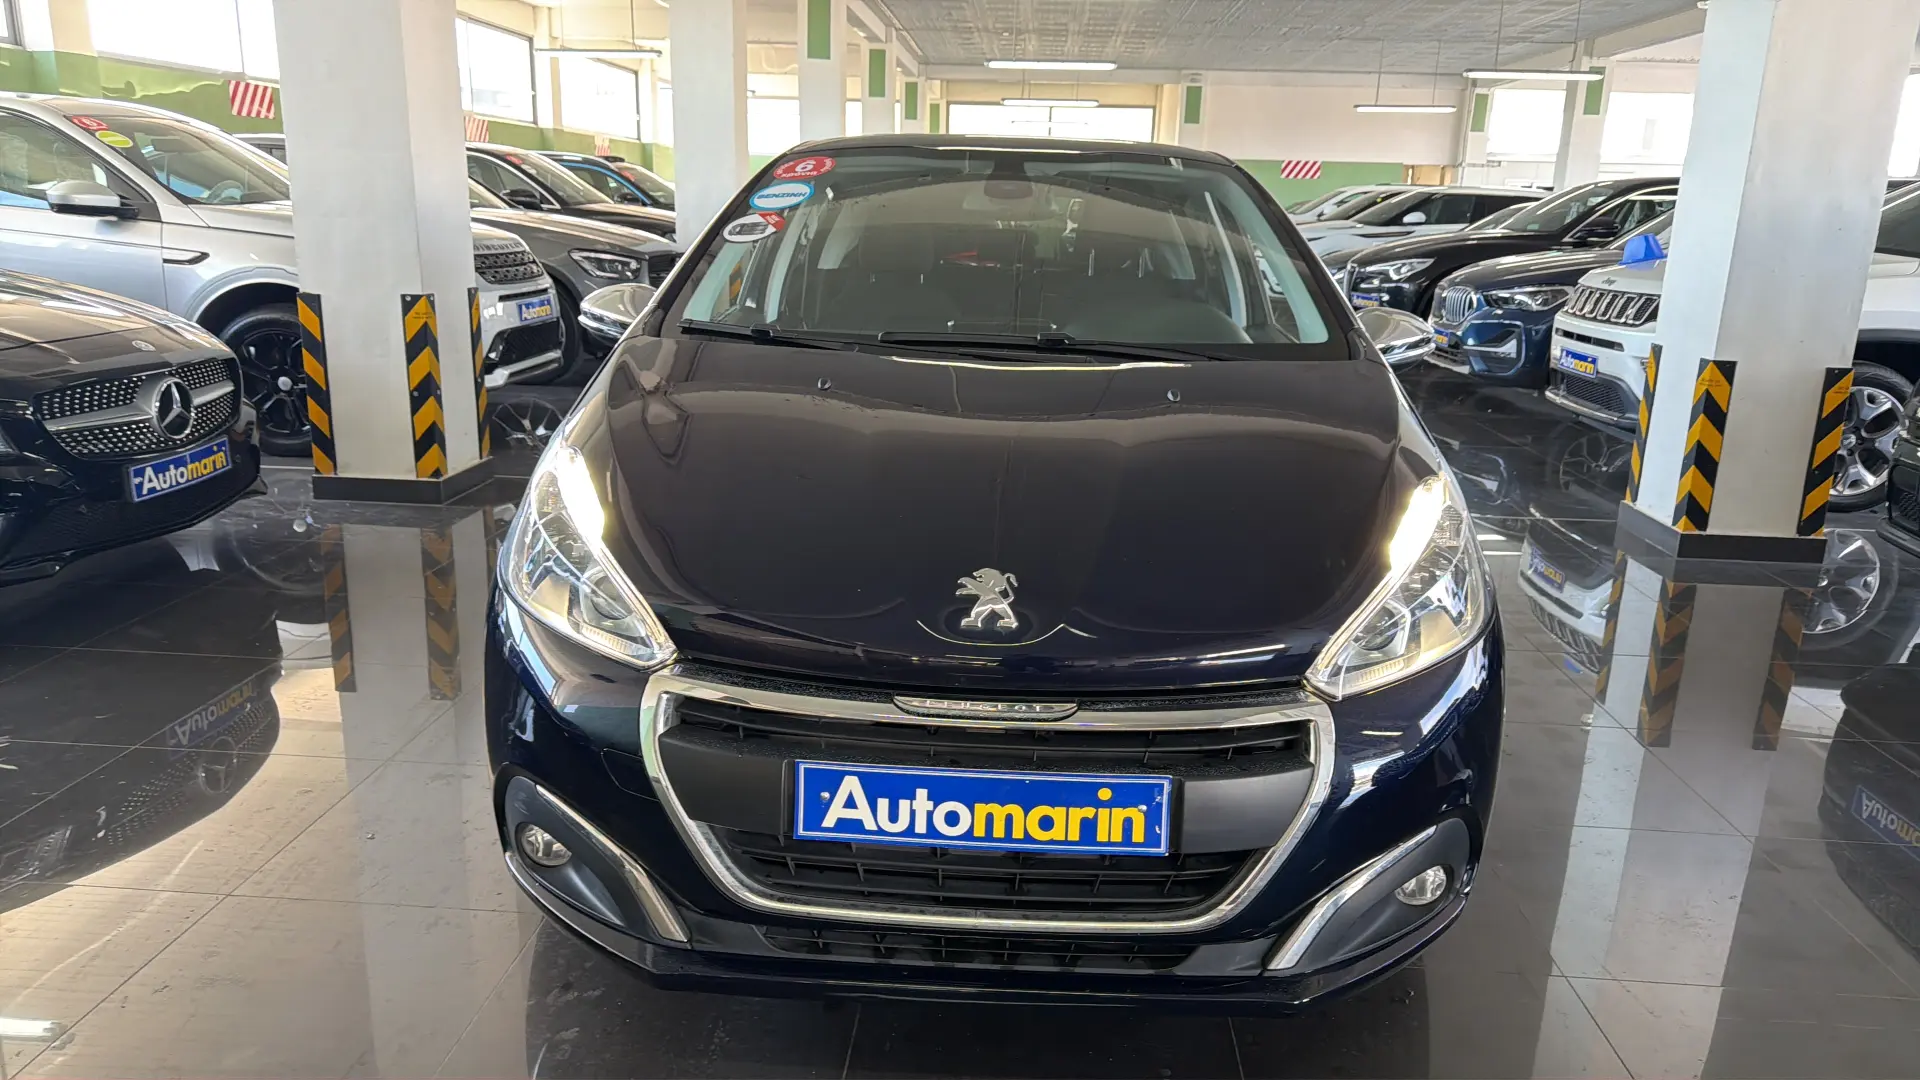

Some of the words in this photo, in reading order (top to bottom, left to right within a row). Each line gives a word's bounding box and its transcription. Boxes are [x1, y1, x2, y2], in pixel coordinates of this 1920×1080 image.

[795, 160, 816, 172] 6
[1560, 350, 1595, 374] Automarin
[142, 445, 227, 495] Automarin
[821, 775, 1146, 842] Automarin
